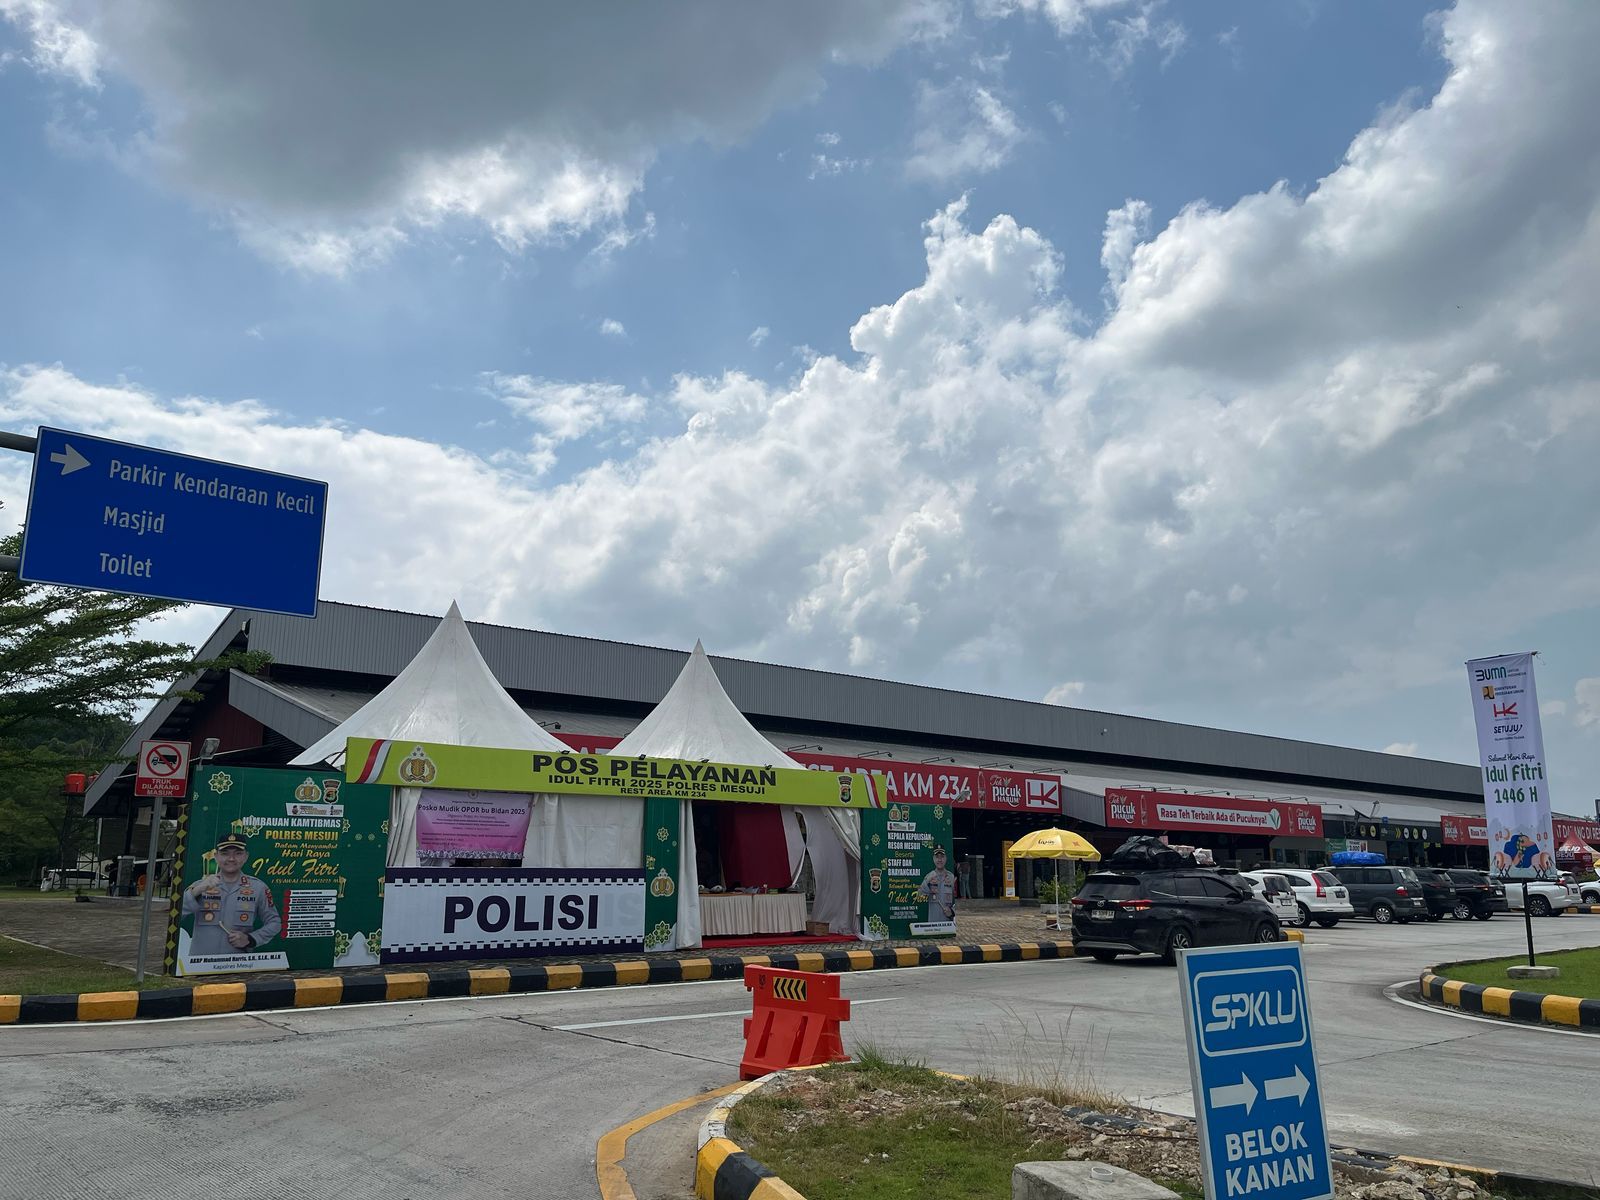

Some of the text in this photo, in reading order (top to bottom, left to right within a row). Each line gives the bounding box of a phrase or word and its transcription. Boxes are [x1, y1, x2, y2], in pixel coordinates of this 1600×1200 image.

[109, 459, 314, 515] Parkir Kendaraan Kecil
[103, 505, 165, 535] Masjid
[99, 552, 152, 578] Toilet
[1475, 666, 1507, 681] BUMN
[1493, 702, 1518, 717] HK
[1493, 724, 1520, 734] SETUJU
[1488, 752, 1536, 762] Selamat Hari Raya
[533, 754, 777, 786] POS PELAYANAN
[1485, 762, 1543, 783] Idul Fitri
[549, 774, 765, 795] IDUL FITRI 2025 POLRES MESUJI
[903, 772, 934, 798] KM
[938, 774, 972, 801] 234
[1027, 781, 1058, 805] HK
[1494, 785, 1538, 803] 1446 H
[418, 804, 438, 812] Posko
[1160, 808, 1267, 826] Rasa Teh Terbaik Ada di Pucuknya!
[243, 816, 341, 828] HIMBAUAN KAMTIBMAS
[265, 830, 339, 841] POLRES MESUJI
[282, 849, 330, 859] Hari Raya
[252, 857, 340, 879] I'dul Fitri
[443, 894, 599, 934] POLISI
[1205, 988, 1297, 1032] SPKLU
[1225, 1121, 1308, 1162] BELOK
[1225, 1153, 1315, 1197] KANAN
